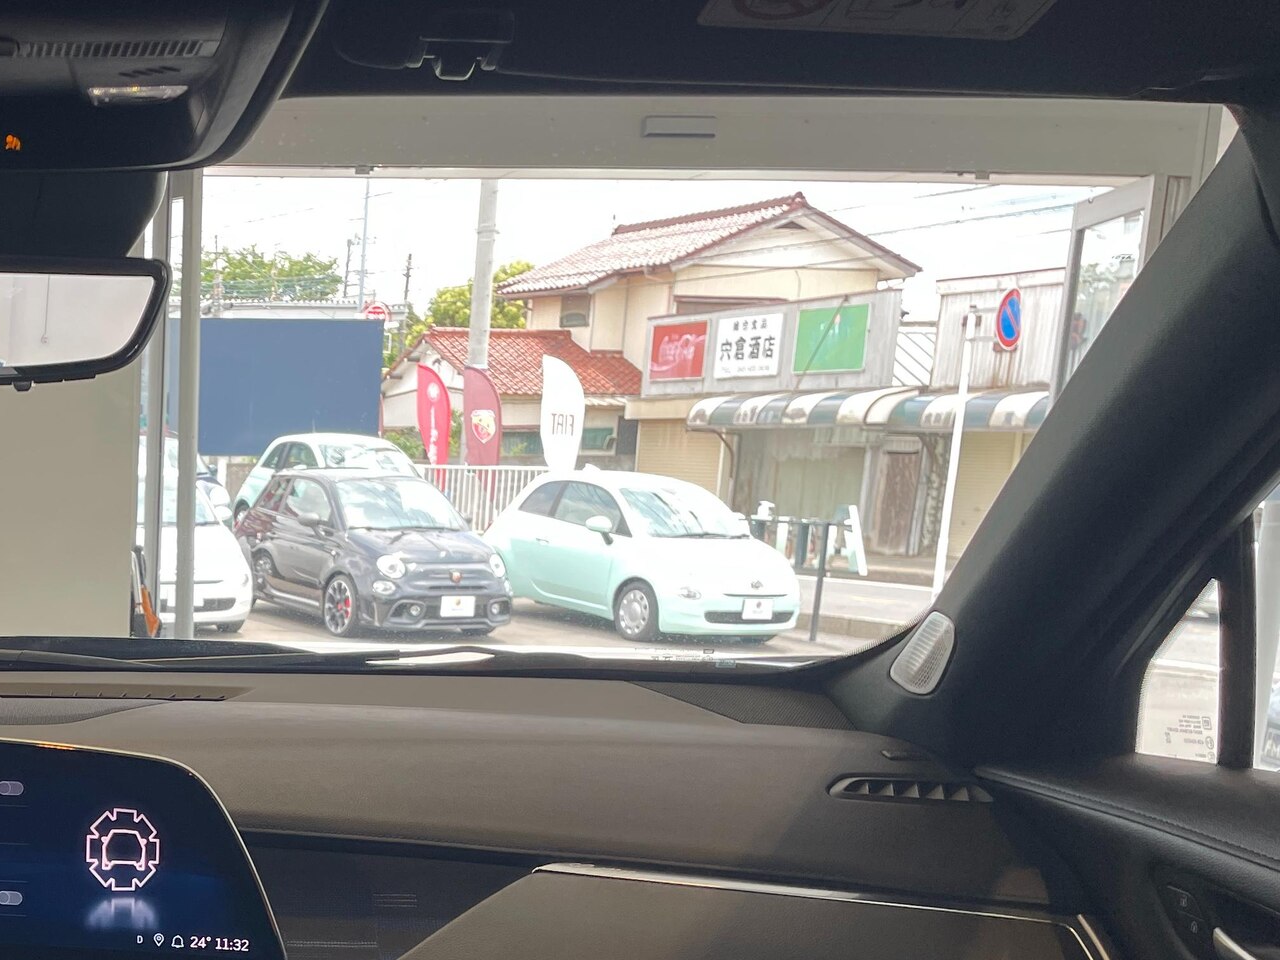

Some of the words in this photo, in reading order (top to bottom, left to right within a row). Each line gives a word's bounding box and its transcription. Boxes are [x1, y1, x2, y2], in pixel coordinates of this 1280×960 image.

[136, 935, 144, 944] D
[190, 936, 212, 948] 24°
[215, 938, 250, 952] 11:32
